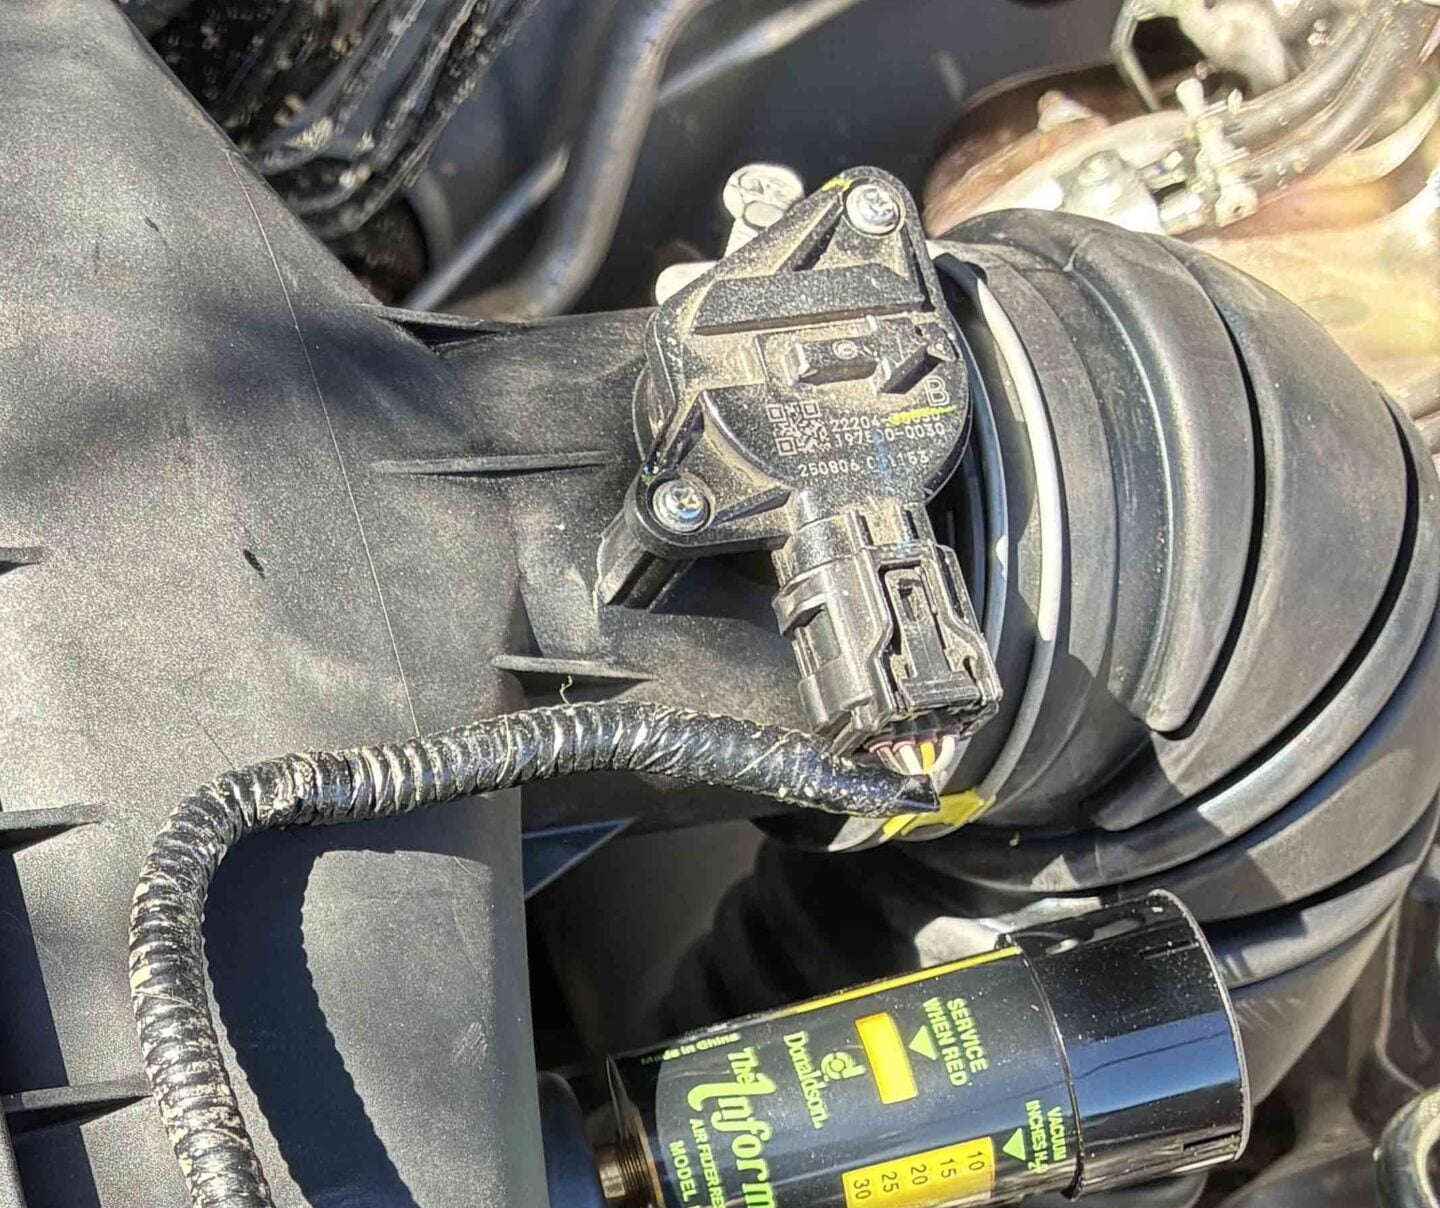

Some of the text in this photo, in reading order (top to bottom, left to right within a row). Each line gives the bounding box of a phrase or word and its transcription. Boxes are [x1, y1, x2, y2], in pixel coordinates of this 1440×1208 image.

[797, 458, 860, 478] 250806
[923, 997, 968, 1087] WHEN RED
[946, 997, 987, 1073] SERVICE
[726, 1045, 763, 1086] The
[689, 1116, 711, 1144] AIR
[1026, 1100, 1046, 1152] INCHES
[1046, 1107, 1067, 1162] VACUUM
[669, 1140, 698, 1202] MODEL
[697, 1142, 721, 1188] FILTER
[909, 1163, 929, 1187] 20
[938, 1157, 958, 1180] 15
[965, 1149, 986, 1172] 10
[852, 1177, 873, 1202] 30
[880, 1170, 901, 1194] 25
